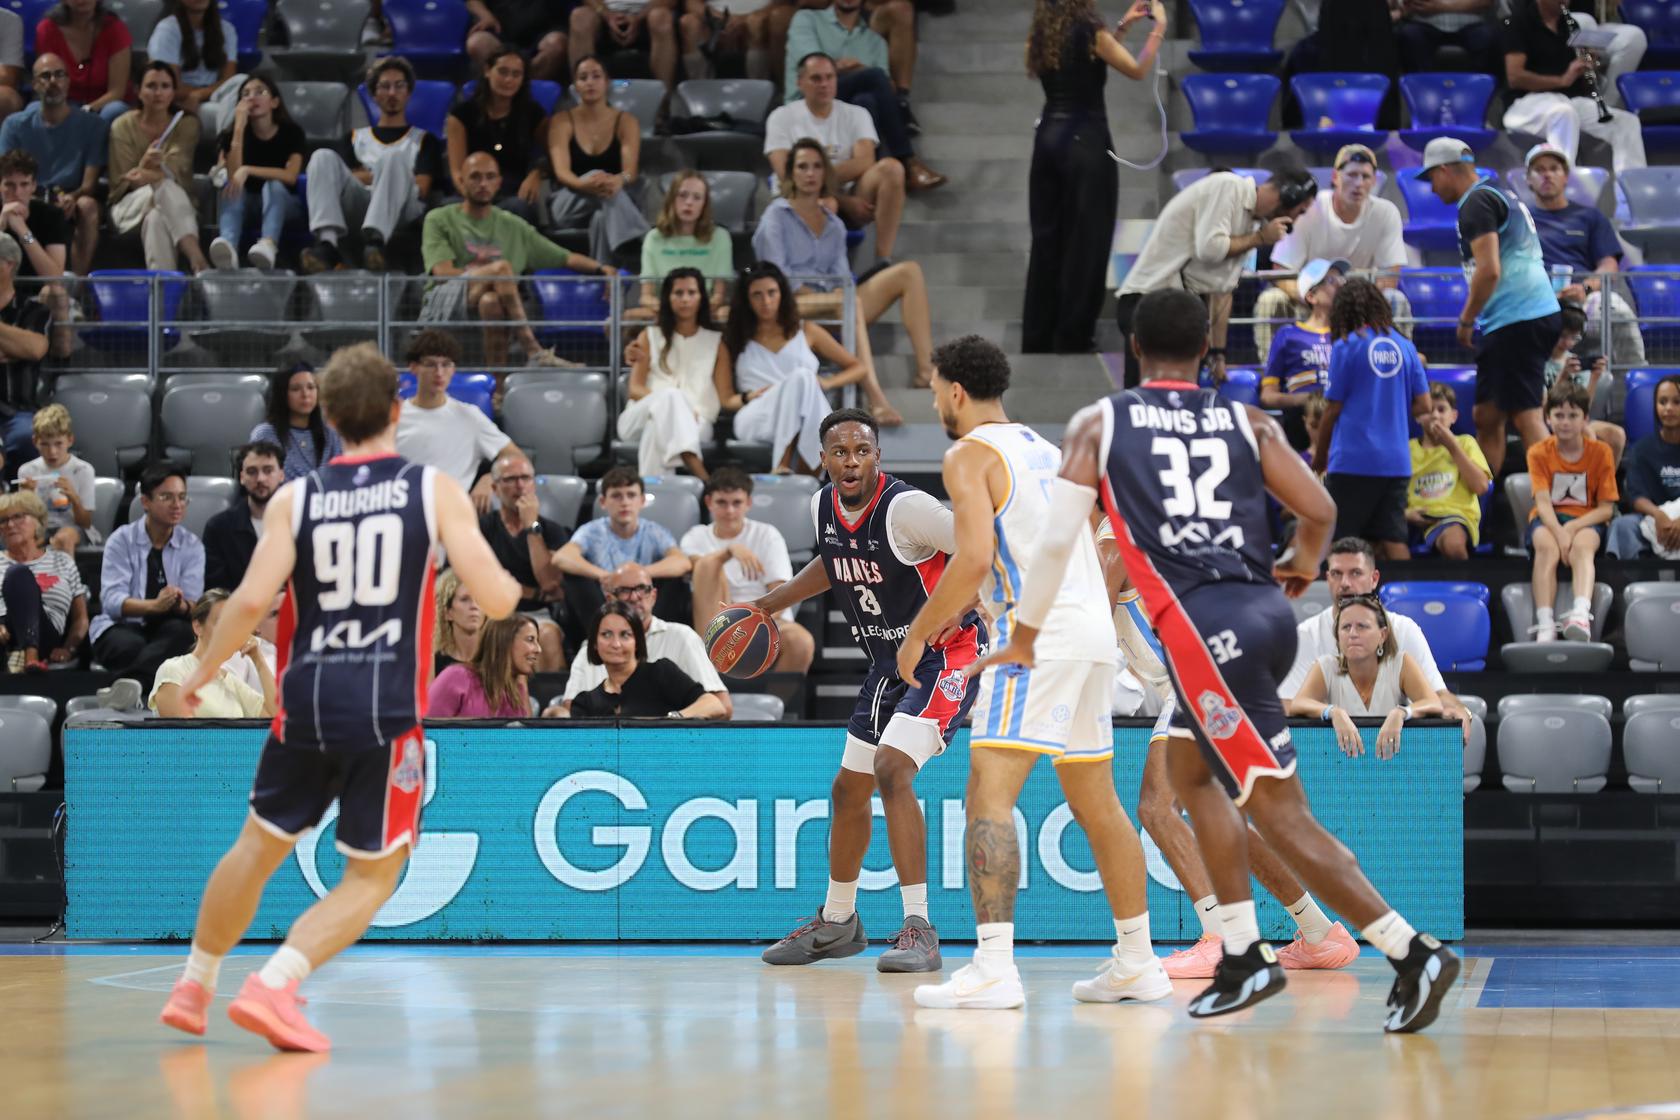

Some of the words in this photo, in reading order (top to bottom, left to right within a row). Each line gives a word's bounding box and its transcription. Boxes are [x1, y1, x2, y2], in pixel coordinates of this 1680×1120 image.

[1374, 350, 1398, 365] PARIS
[1129, 404, 1197, 435] DAVIS
[1201, 407, 1234, 433] JR
[1151, 437, 1233, 520] 32
[309, 479, 410, 521] BOURHIS
[312, 513, 404, 612] 90
[861, 624, 910, 641] LEGNDR
[1207, 629, 1243, 664] 32
[534, 769, 1188, 892] Garnc
